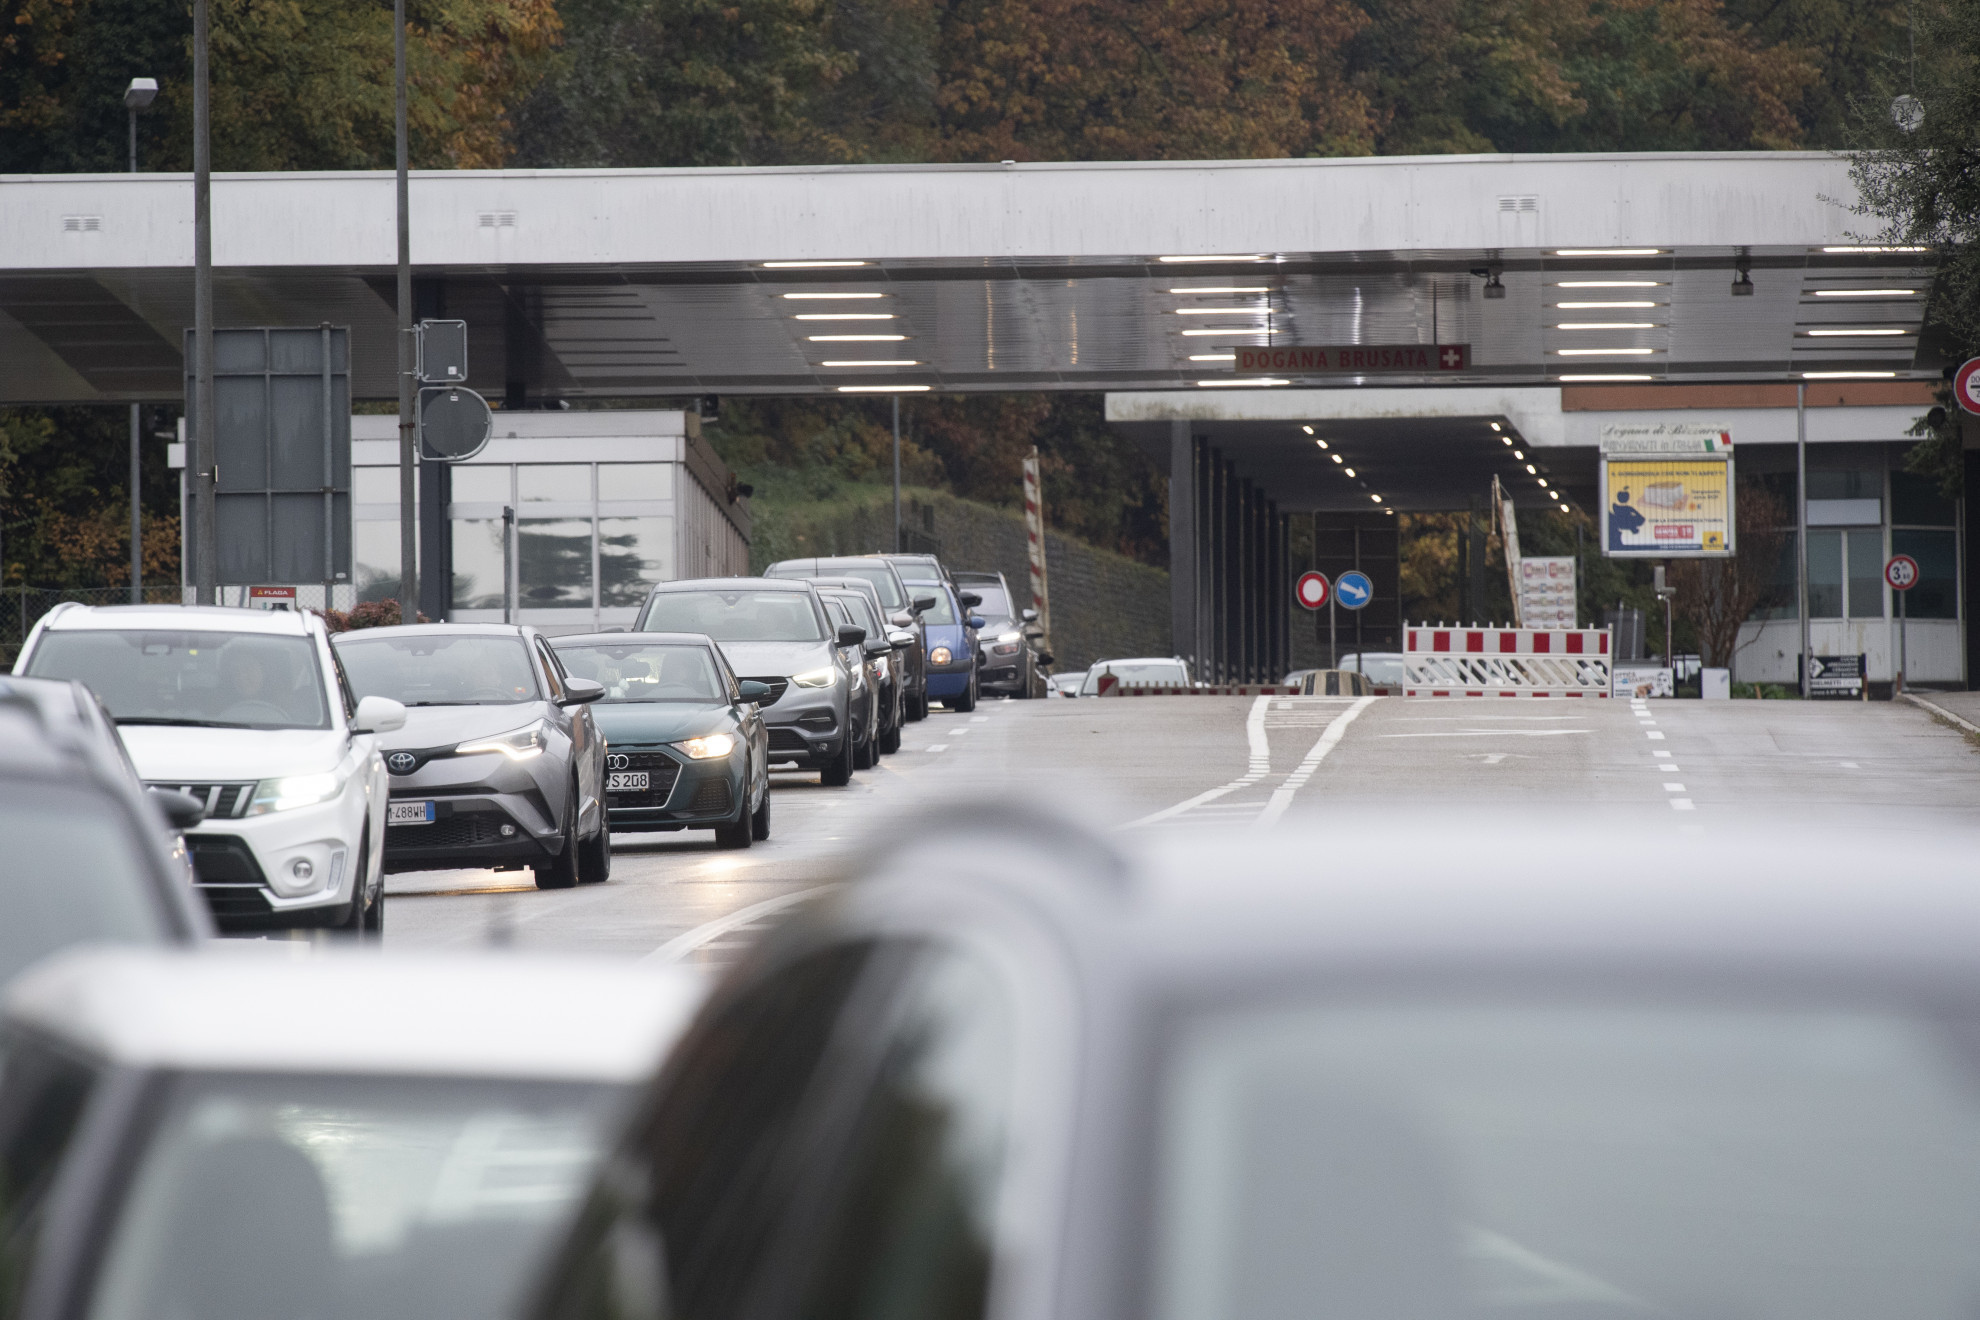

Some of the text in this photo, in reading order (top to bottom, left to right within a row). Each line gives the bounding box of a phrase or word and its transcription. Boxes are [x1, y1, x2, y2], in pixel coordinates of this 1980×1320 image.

[1243, 350, 1428, 369] DOGANA BRUSATA
[1893, 566, 1900, 580] 3
[623, 773, 648, 788] 208
